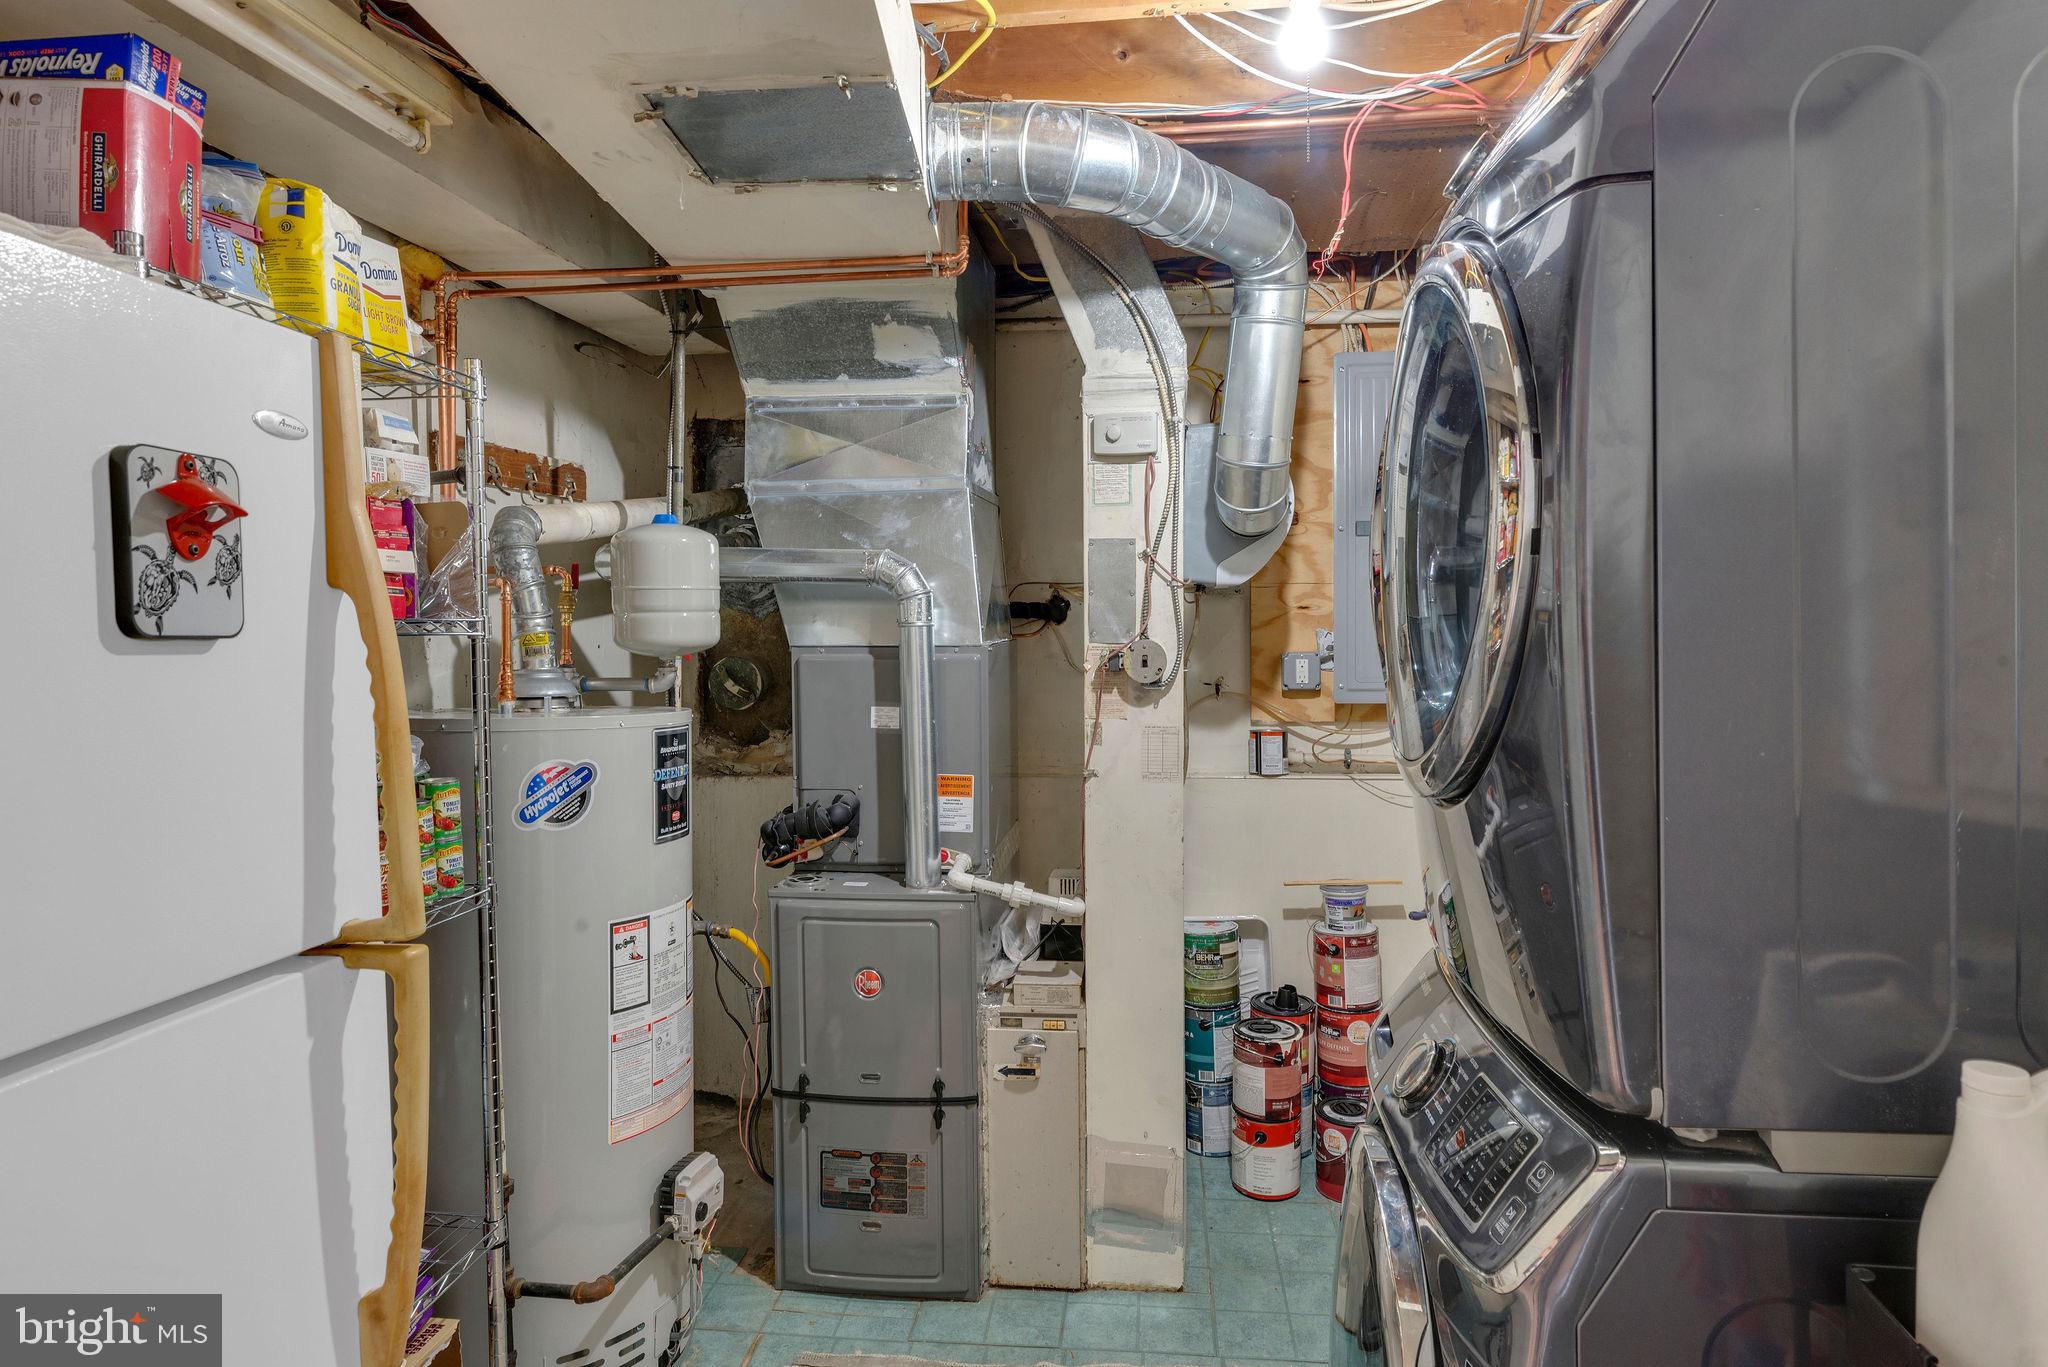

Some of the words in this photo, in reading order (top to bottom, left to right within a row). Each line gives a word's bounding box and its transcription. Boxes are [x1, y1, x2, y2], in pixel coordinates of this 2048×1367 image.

[10, 48, 103, 77] Reynolds
[137, 41, 150, 86] Reynolds
[151, 47, 163, 71] 200
[146, 66, 159, 93] Wrap
[177, 80, 203, 98] eynolds
[177, 85, 188, 100] rap
[190, 99, 202, 111] 75
[94, 135, 103, 209] GHIRARDELLI
[186, 166, 194, 240] GHIRARDELLI
[215, 234, 231, 269] Arroz
[231, 236, 246, 267] our
[360, 261, 398, 281] Domino
[363, 306, 384, 322] LIGHT
[386, 312, 409, 330] BROWN
[379, 322, 399, 335] SUGAR
[279, 418, 305, 433] Amana
[371, 471, 381, 483] 50
[661, 781, 676, 790] SAFETY
[523, 780, 570, 820] Hydrojet
[625, 923, 644, 931] DANGER
[1195, 953, 1214, 961] BEHR
[858, 972, 880, 992] Rheem
[1320, 1024, 1333, 1036] BEHR
[1326, 1043, 1350, 1052] DEFENSE
